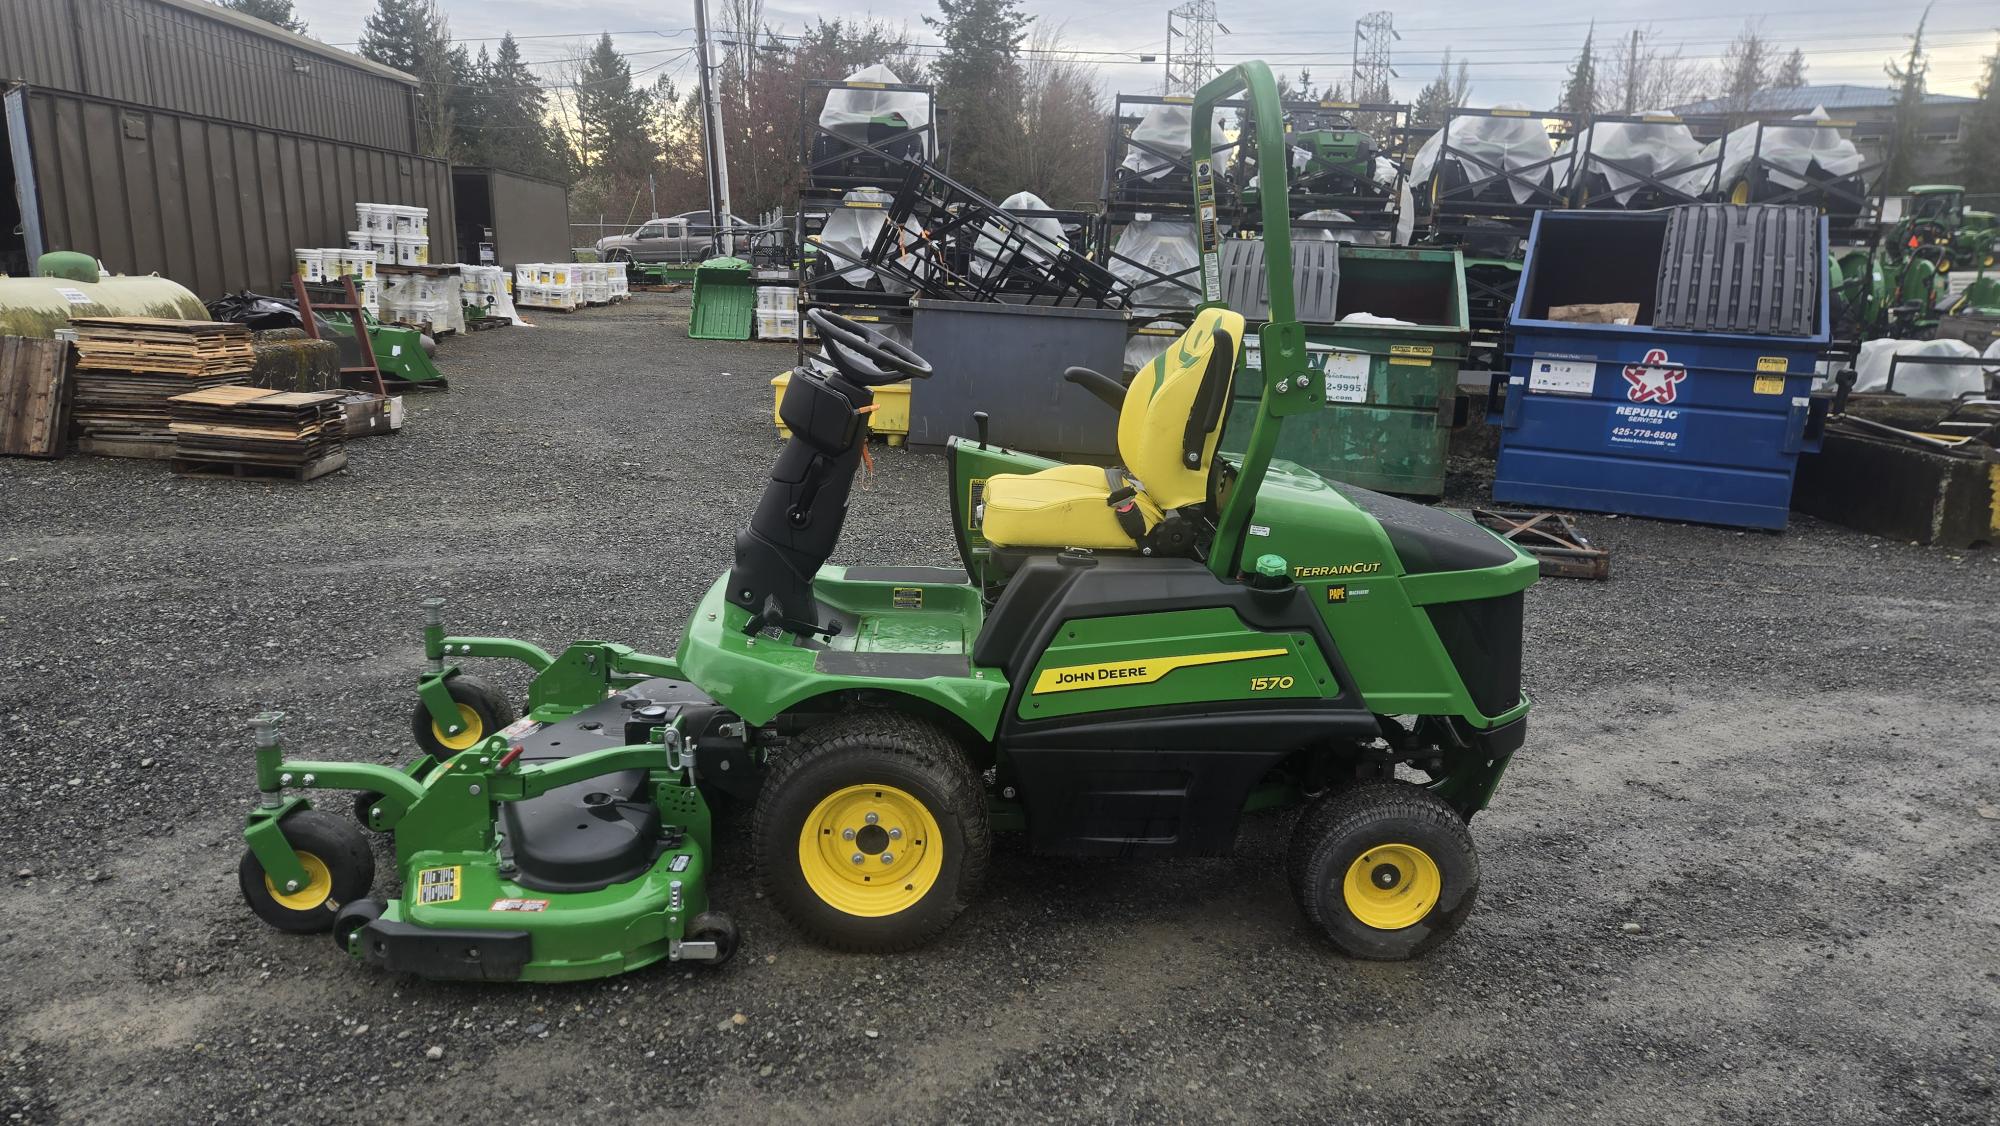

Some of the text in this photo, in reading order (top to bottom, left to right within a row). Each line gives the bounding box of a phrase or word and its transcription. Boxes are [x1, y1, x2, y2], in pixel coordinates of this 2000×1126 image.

[1327, 383, 1361, 392] 2-9995
[1616, 406, 1678, 419] REPUBLIC
[1628, 416, 1663, 424] SERVICES
[1612, 427, 1678, 440] 425-778-6508
[1055, 667, 1147, 684] JOHN DEERE
[1251, 676, 1294, 691] 1570
